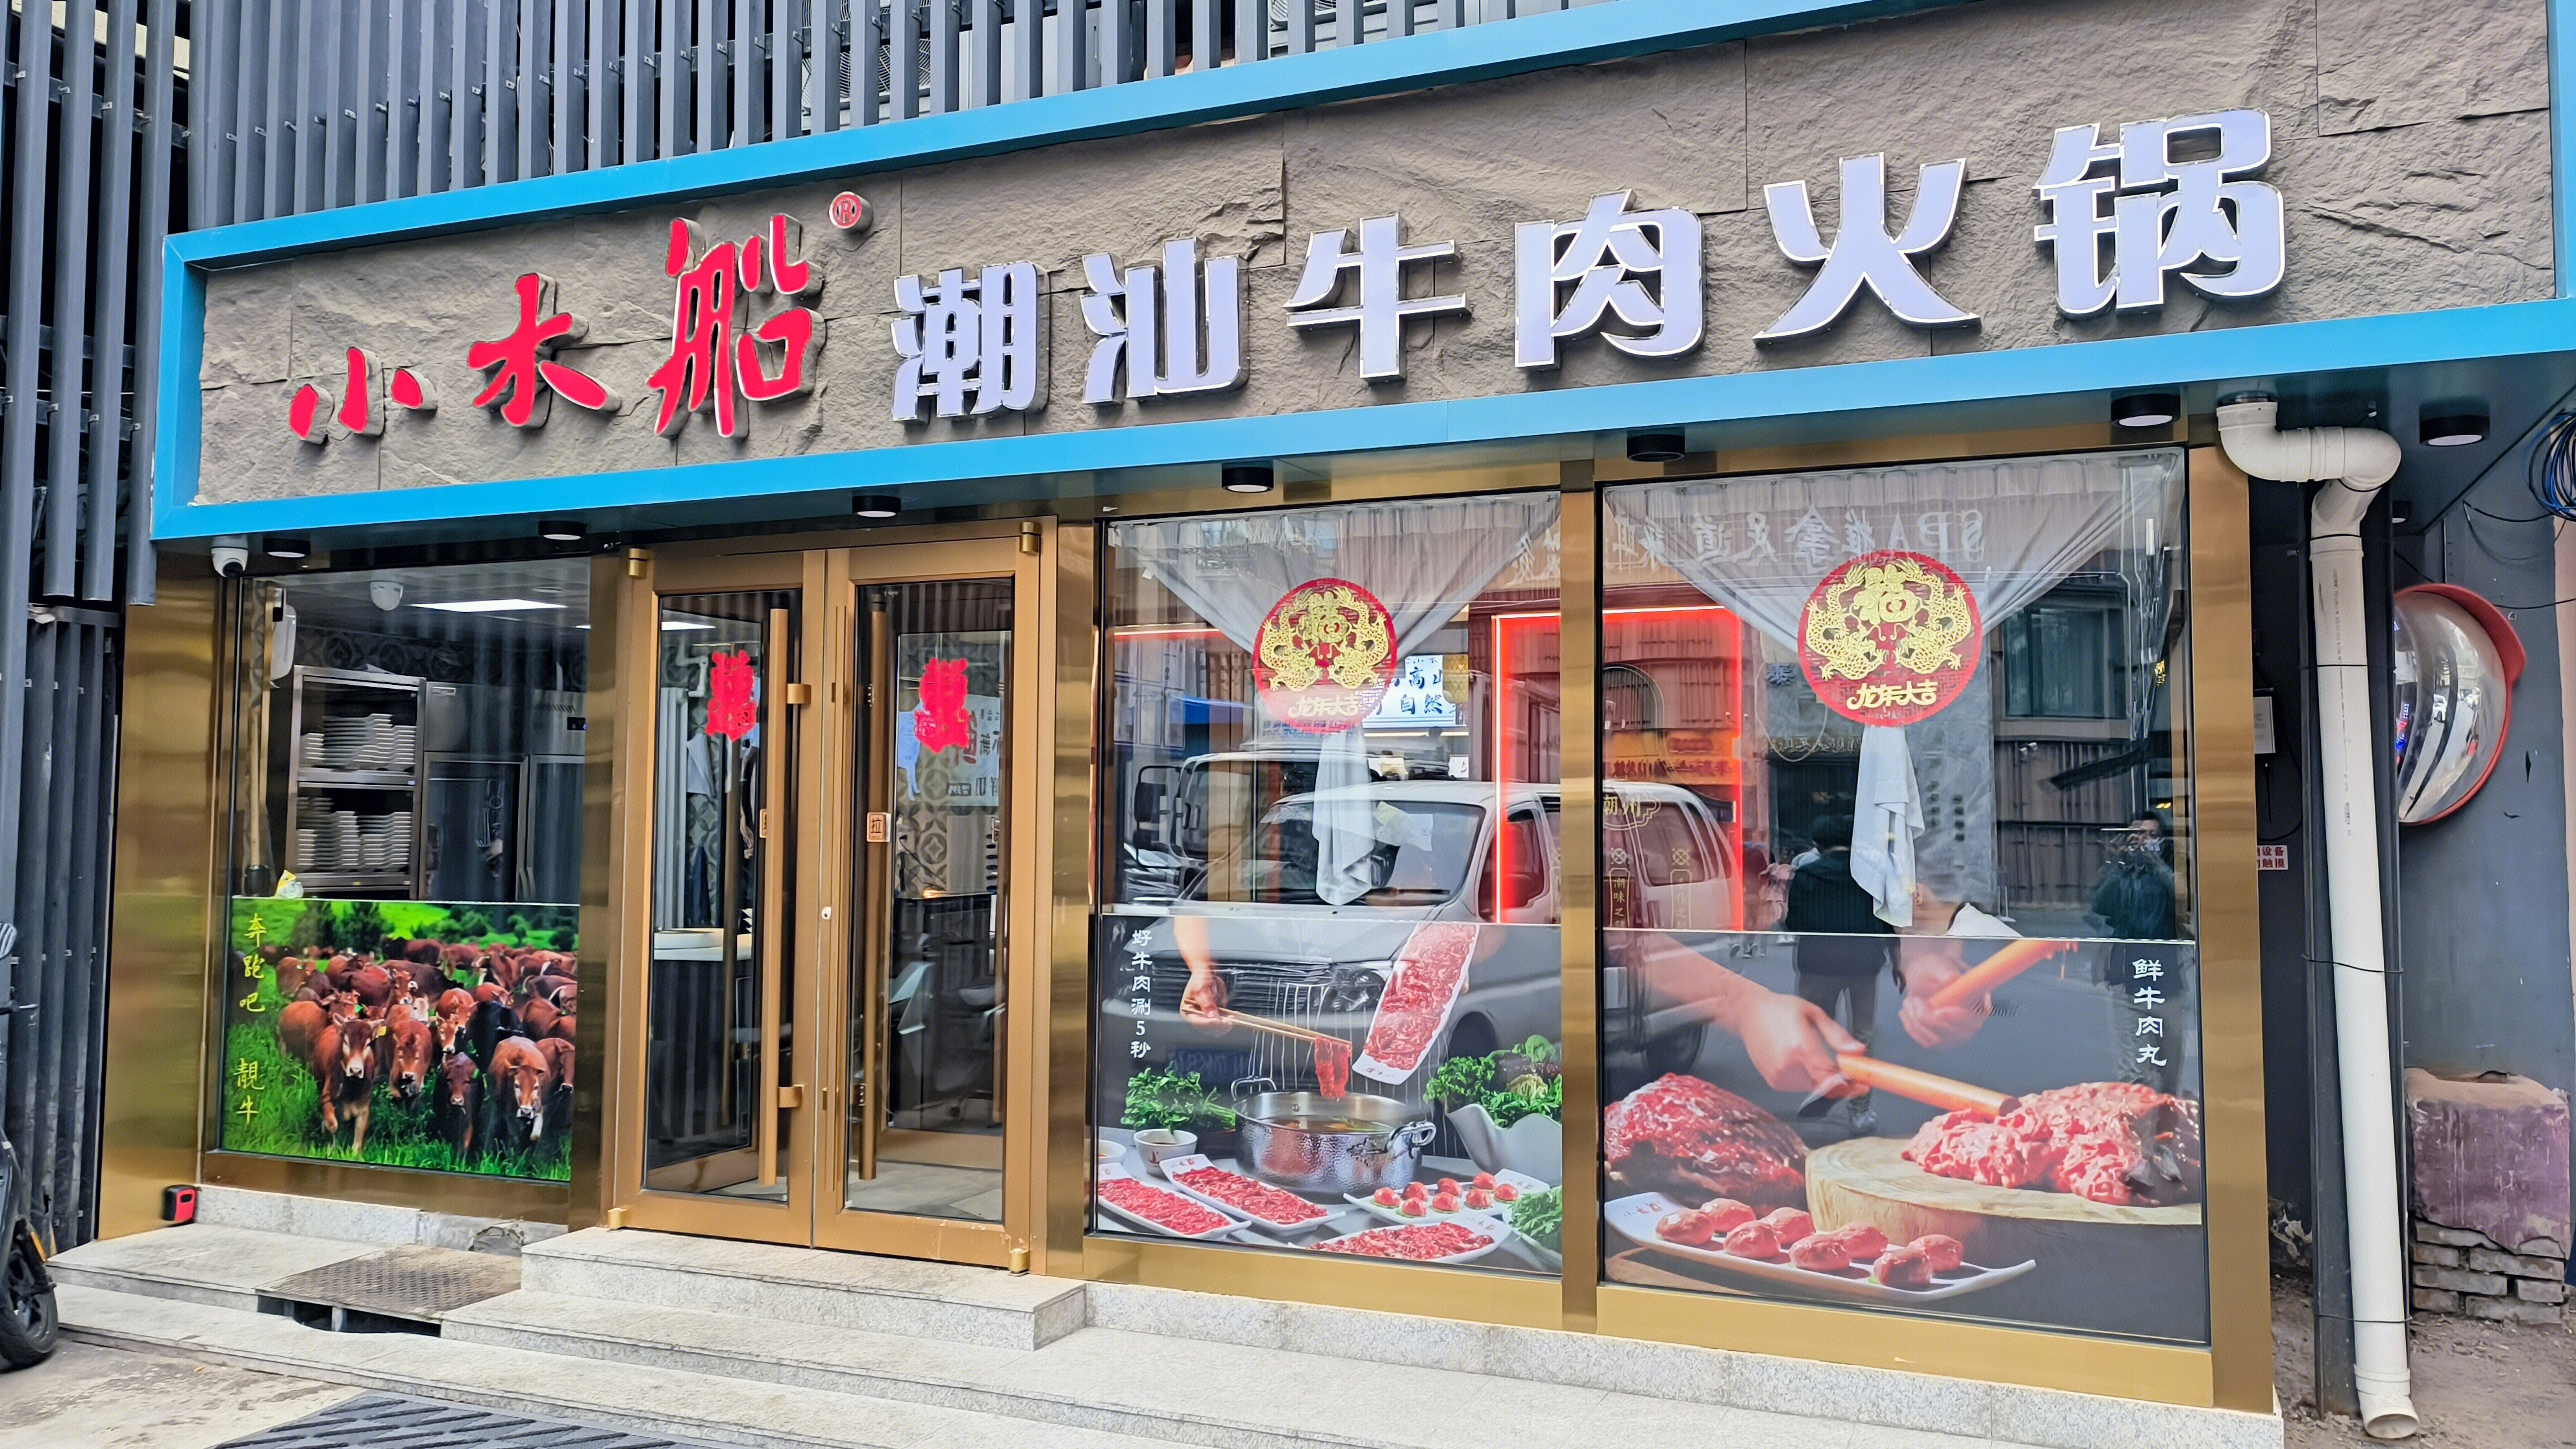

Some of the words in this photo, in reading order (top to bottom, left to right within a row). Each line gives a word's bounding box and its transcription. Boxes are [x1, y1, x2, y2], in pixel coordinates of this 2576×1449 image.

[891, 107, 2288, 421] 潮汕牛肉火锅
[288, 213, 815, 439] 小木船
[1287, 695, 1360, 719] 龙年大吉
[1846, 678, 1938, 710] 龙年大吉
[2257, 846, 2284, 856] 设备
[2257, 858, 2285, 869] 触摸
[237, 912, 267, 1012] 奔跑吧
[1130, 930, 1153, 1059] 好牛肉涮5秒
[2131, 958, 2167, 1067] 鲜牛肉丸
